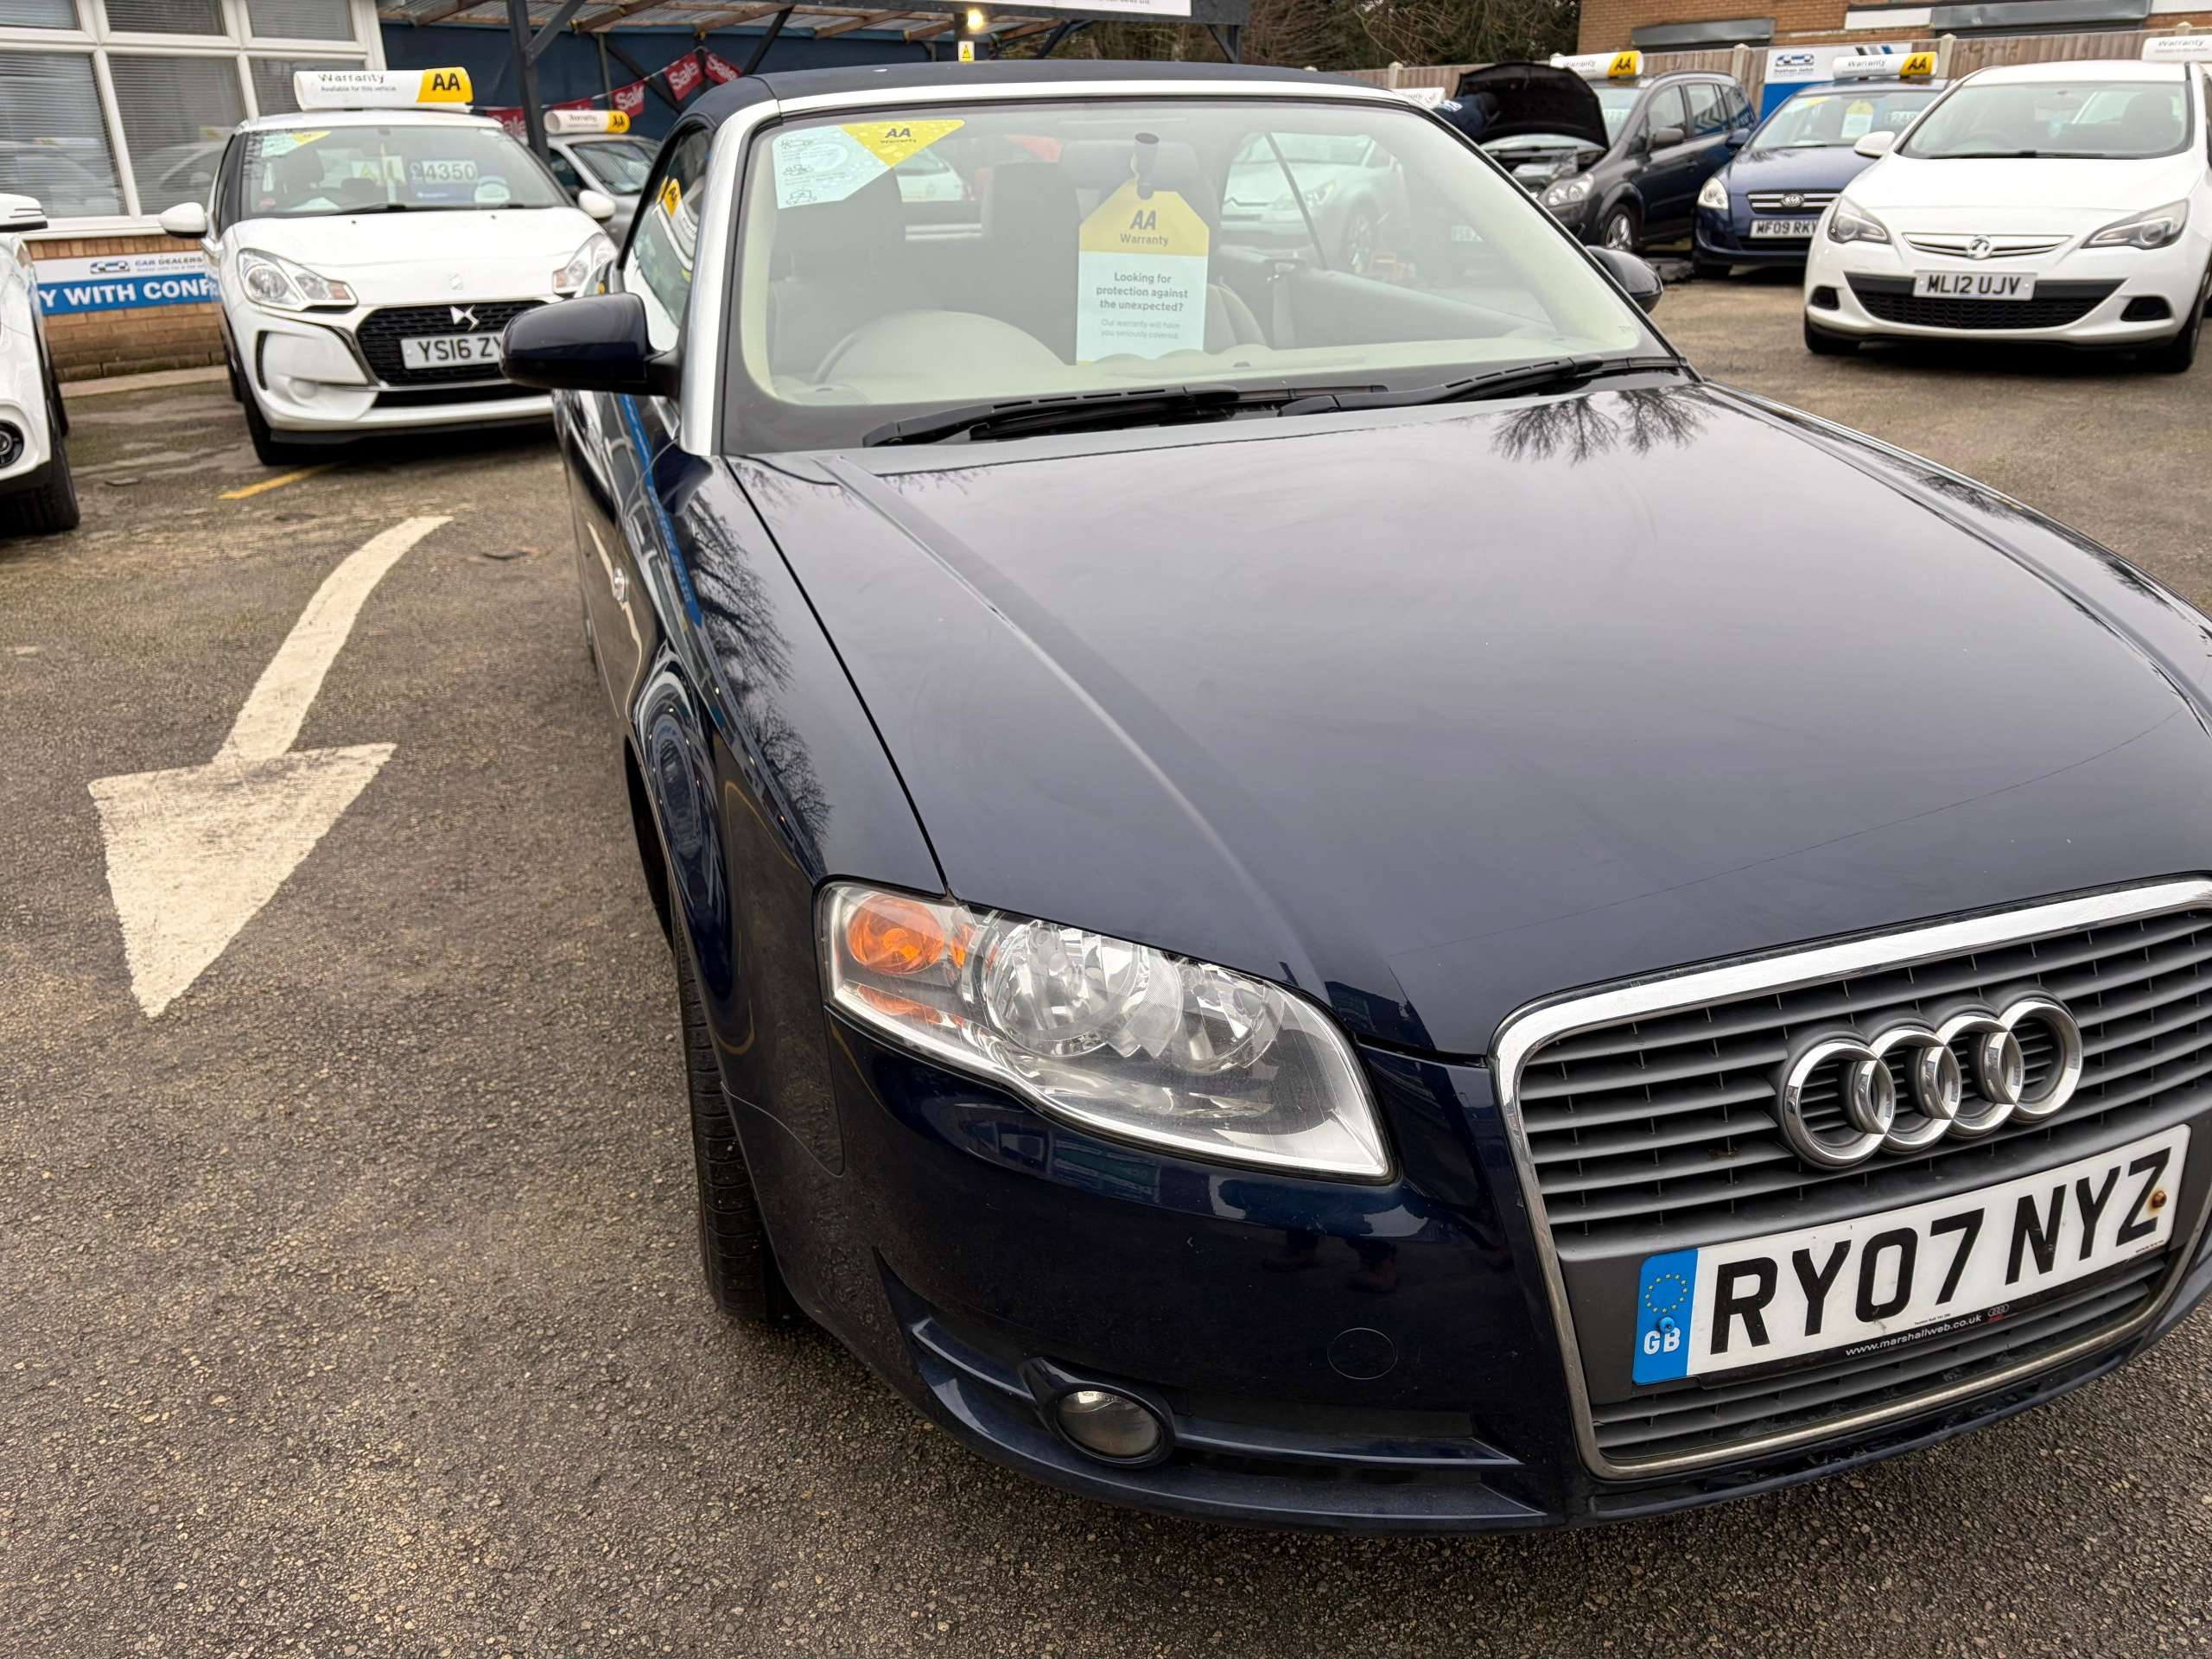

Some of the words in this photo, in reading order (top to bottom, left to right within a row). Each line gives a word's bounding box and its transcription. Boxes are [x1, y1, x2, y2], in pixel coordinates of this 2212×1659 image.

[1615, 58, 1631, 70] AA
[1908, 57, 1927, 69] AA
[318, 74, 385, 84] Warranty
[432, 73, 461, 91] AA
[669, 62, 699, 91] Sale
[885, 128, 912, 138] AA
[1130, 210, 1157, 230] AA
[1120, 233, 1169, 246] Warranty
[1114, 272, 1154, 284] Looking
[1157, 273, 1172, 283] for
[1927, 274, 1973, 295] ML12
[1978, 276, 2022, 296] UJV
[64, 283, 137, 306] WITH
[1096, 286, 1149, 296] protection
[1151, 288, 1188, 299] against
[1100, 299, 1116, 308] the
[1118, 301, 1184, 312] unexpected?
[417, 338, 471, 361] YS16
[1710, 1207, 1985, 1356] RY07
[2005, 1146, 2173, 1286] NYZ
[1643, 1327, 1681, 1355] GB
[1845, 1313, 1982, 1356] www.marshallweb.co.uk
